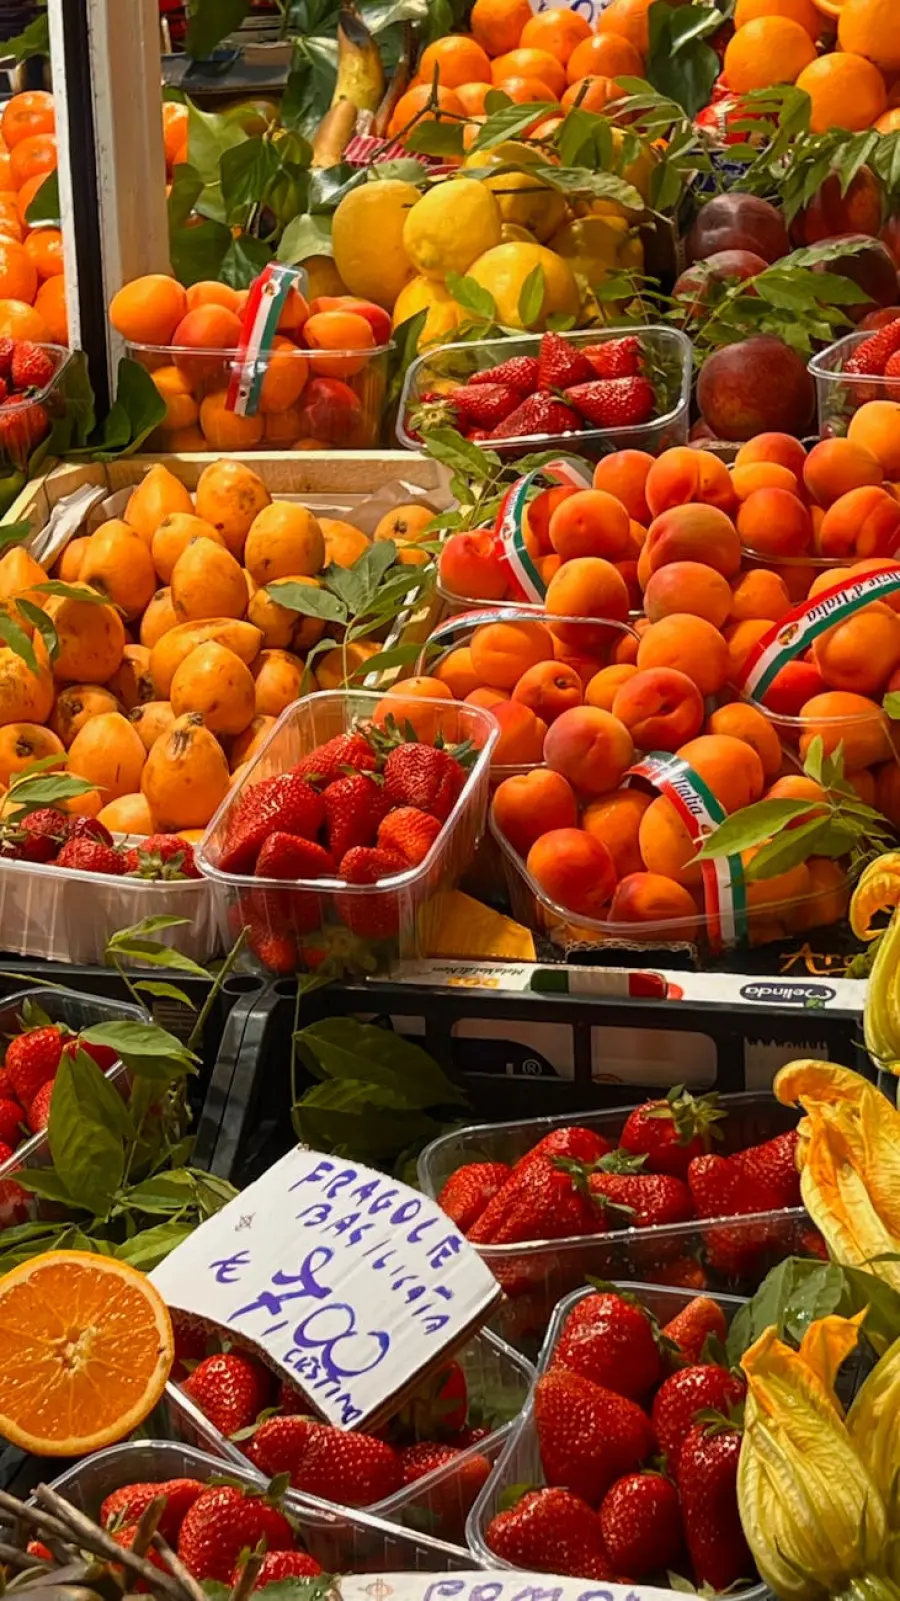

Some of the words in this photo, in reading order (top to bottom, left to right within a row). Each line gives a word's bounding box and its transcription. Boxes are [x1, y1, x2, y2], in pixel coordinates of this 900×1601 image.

[745, 986, 832, 1000] Melinda
[288, 1161, 463, 1270] FRAGOLE
[208, 1250, 251, 1284] €
